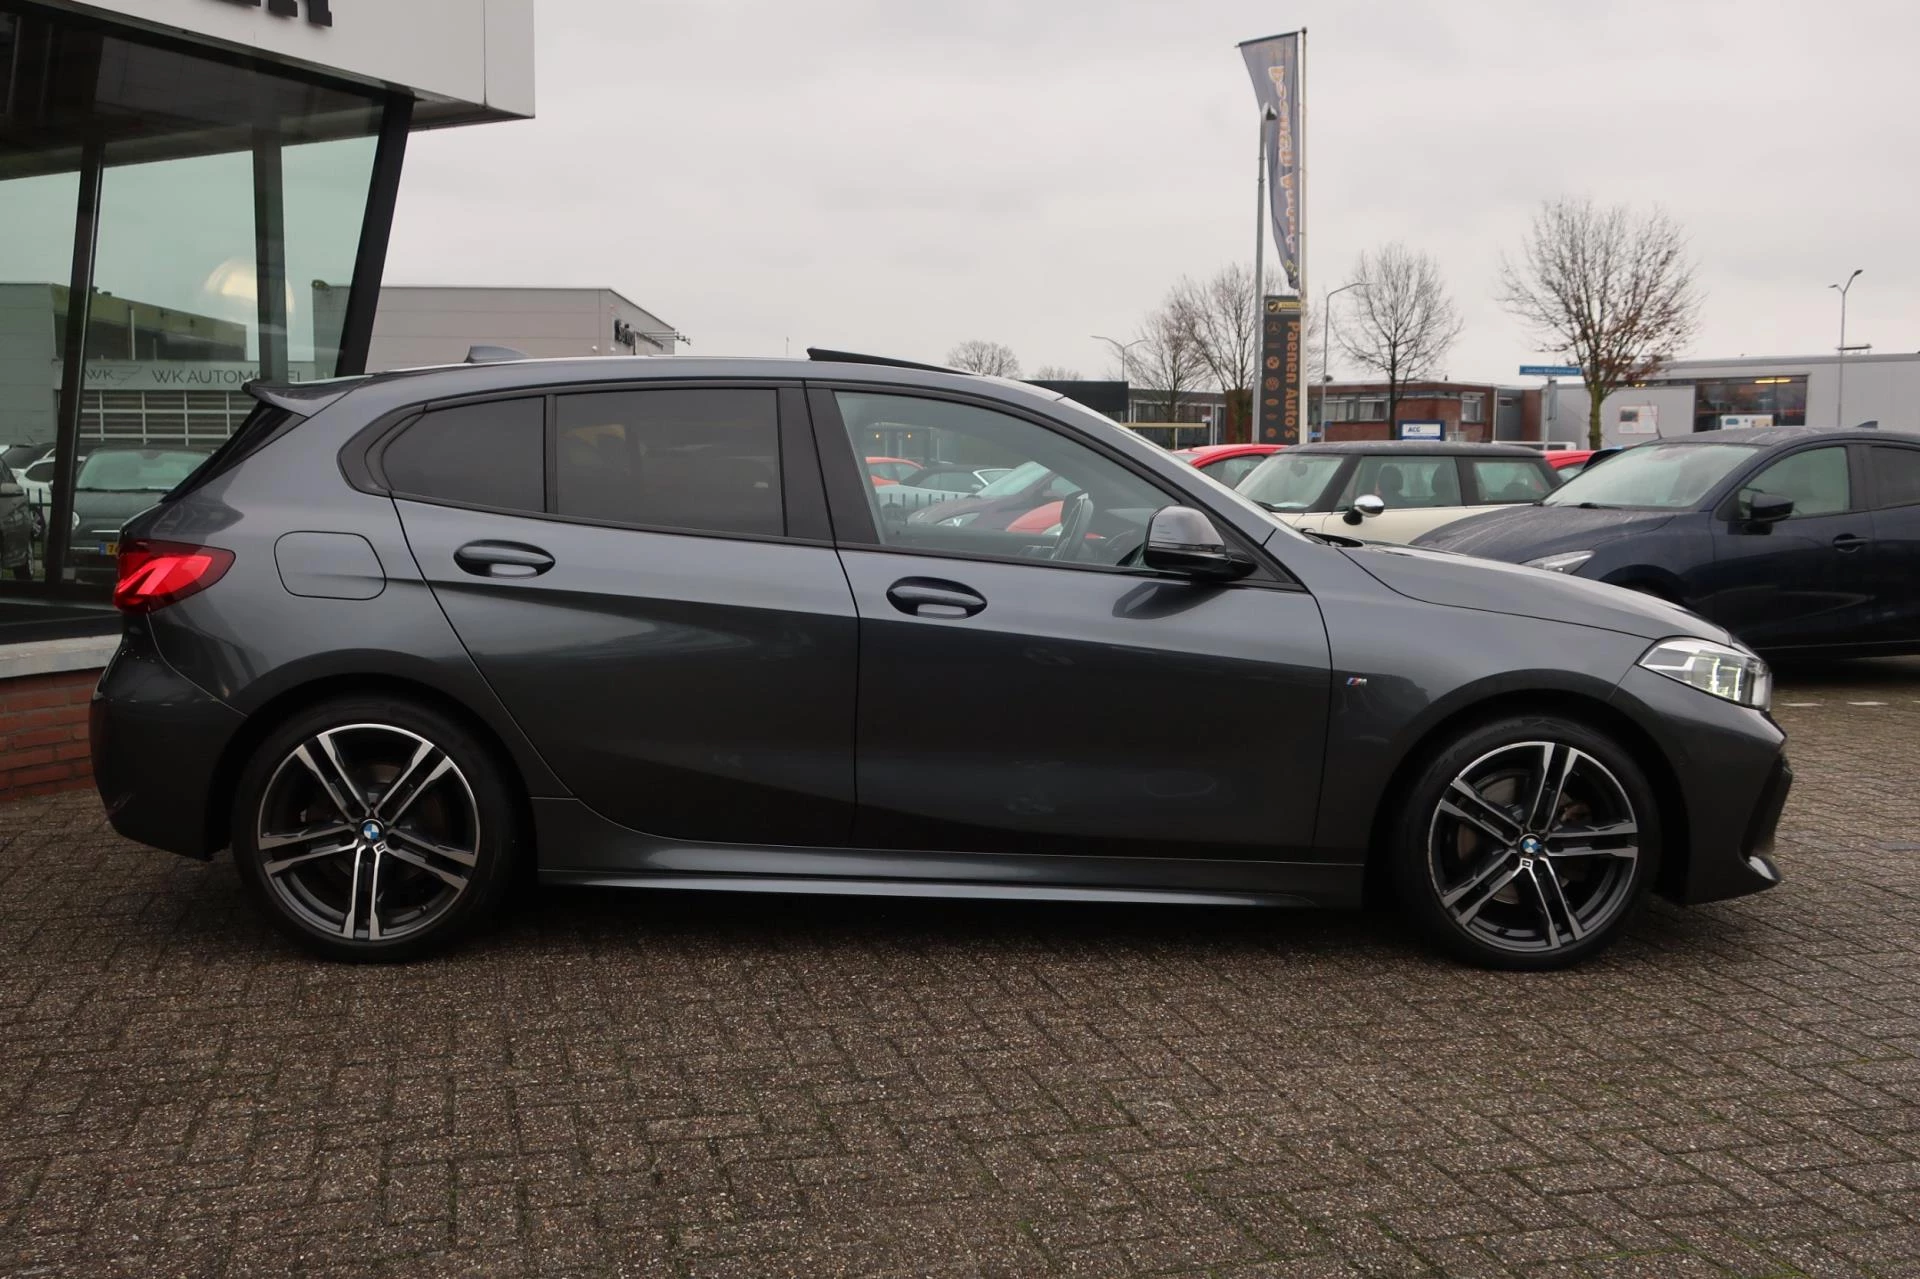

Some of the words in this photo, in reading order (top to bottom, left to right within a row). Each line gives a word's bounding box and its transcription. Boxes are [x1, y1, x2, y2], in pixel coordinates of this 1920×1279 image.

[151, 369, 184, 384] WK
[1286, 321, 1300, 383] Paenen
[1284, 387, 1299, 439] Auto's
